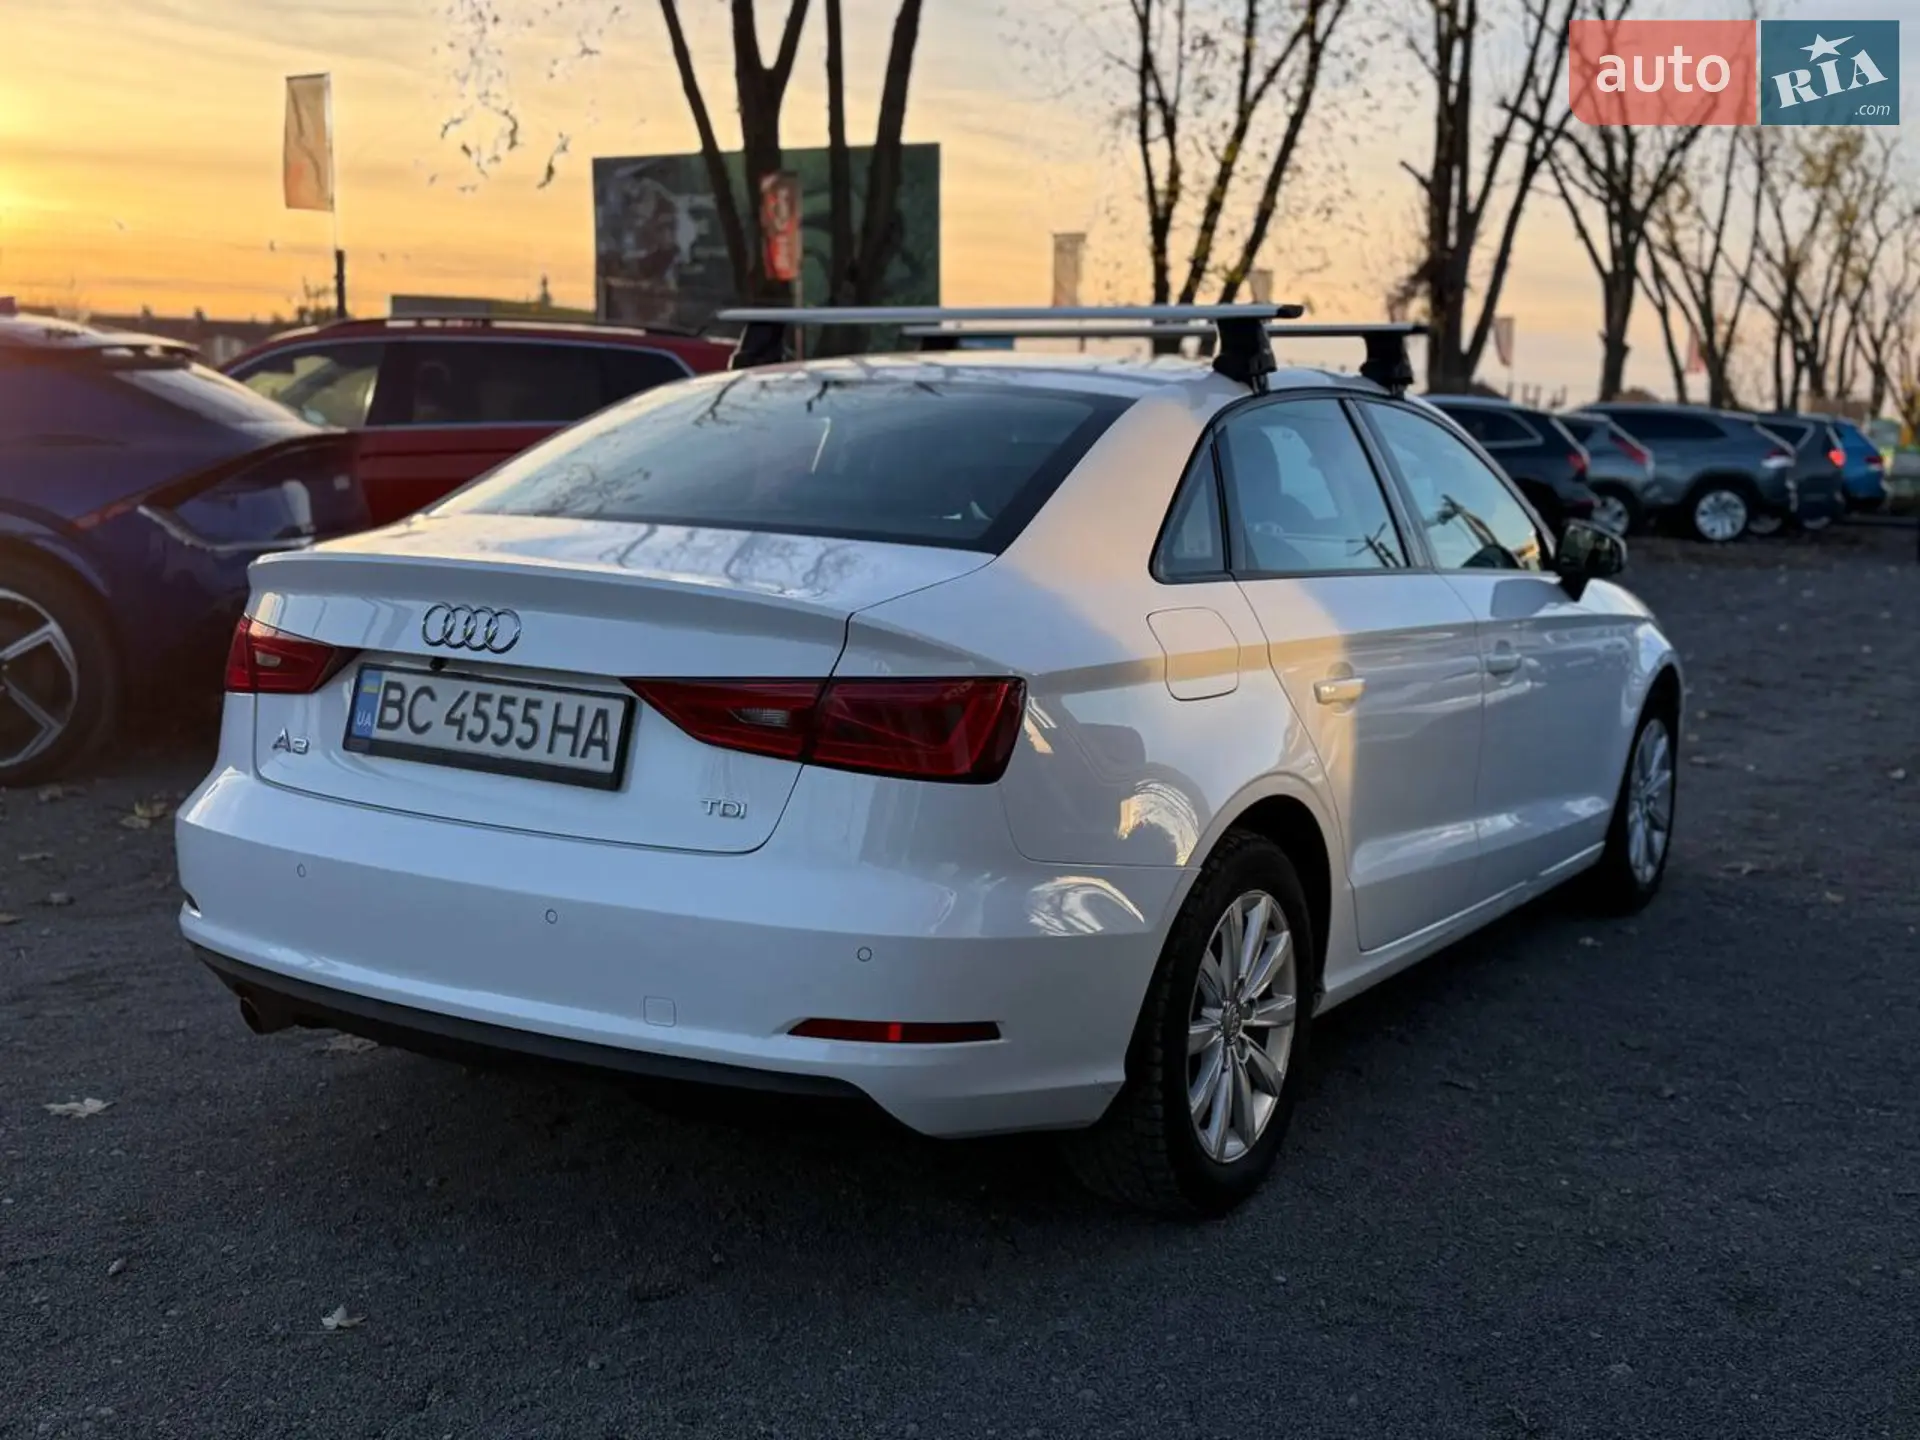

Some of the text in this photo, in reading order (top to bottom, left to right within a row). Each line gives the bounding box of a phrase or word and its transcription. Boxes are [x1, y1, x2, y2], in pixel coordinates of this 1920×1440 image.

[356, 710, 373, 727] UA
[377, 680, 610, 762] BC 4555 HA
[272, 727, 310, 756] A3
[700, 798, 748, 820] TDI
